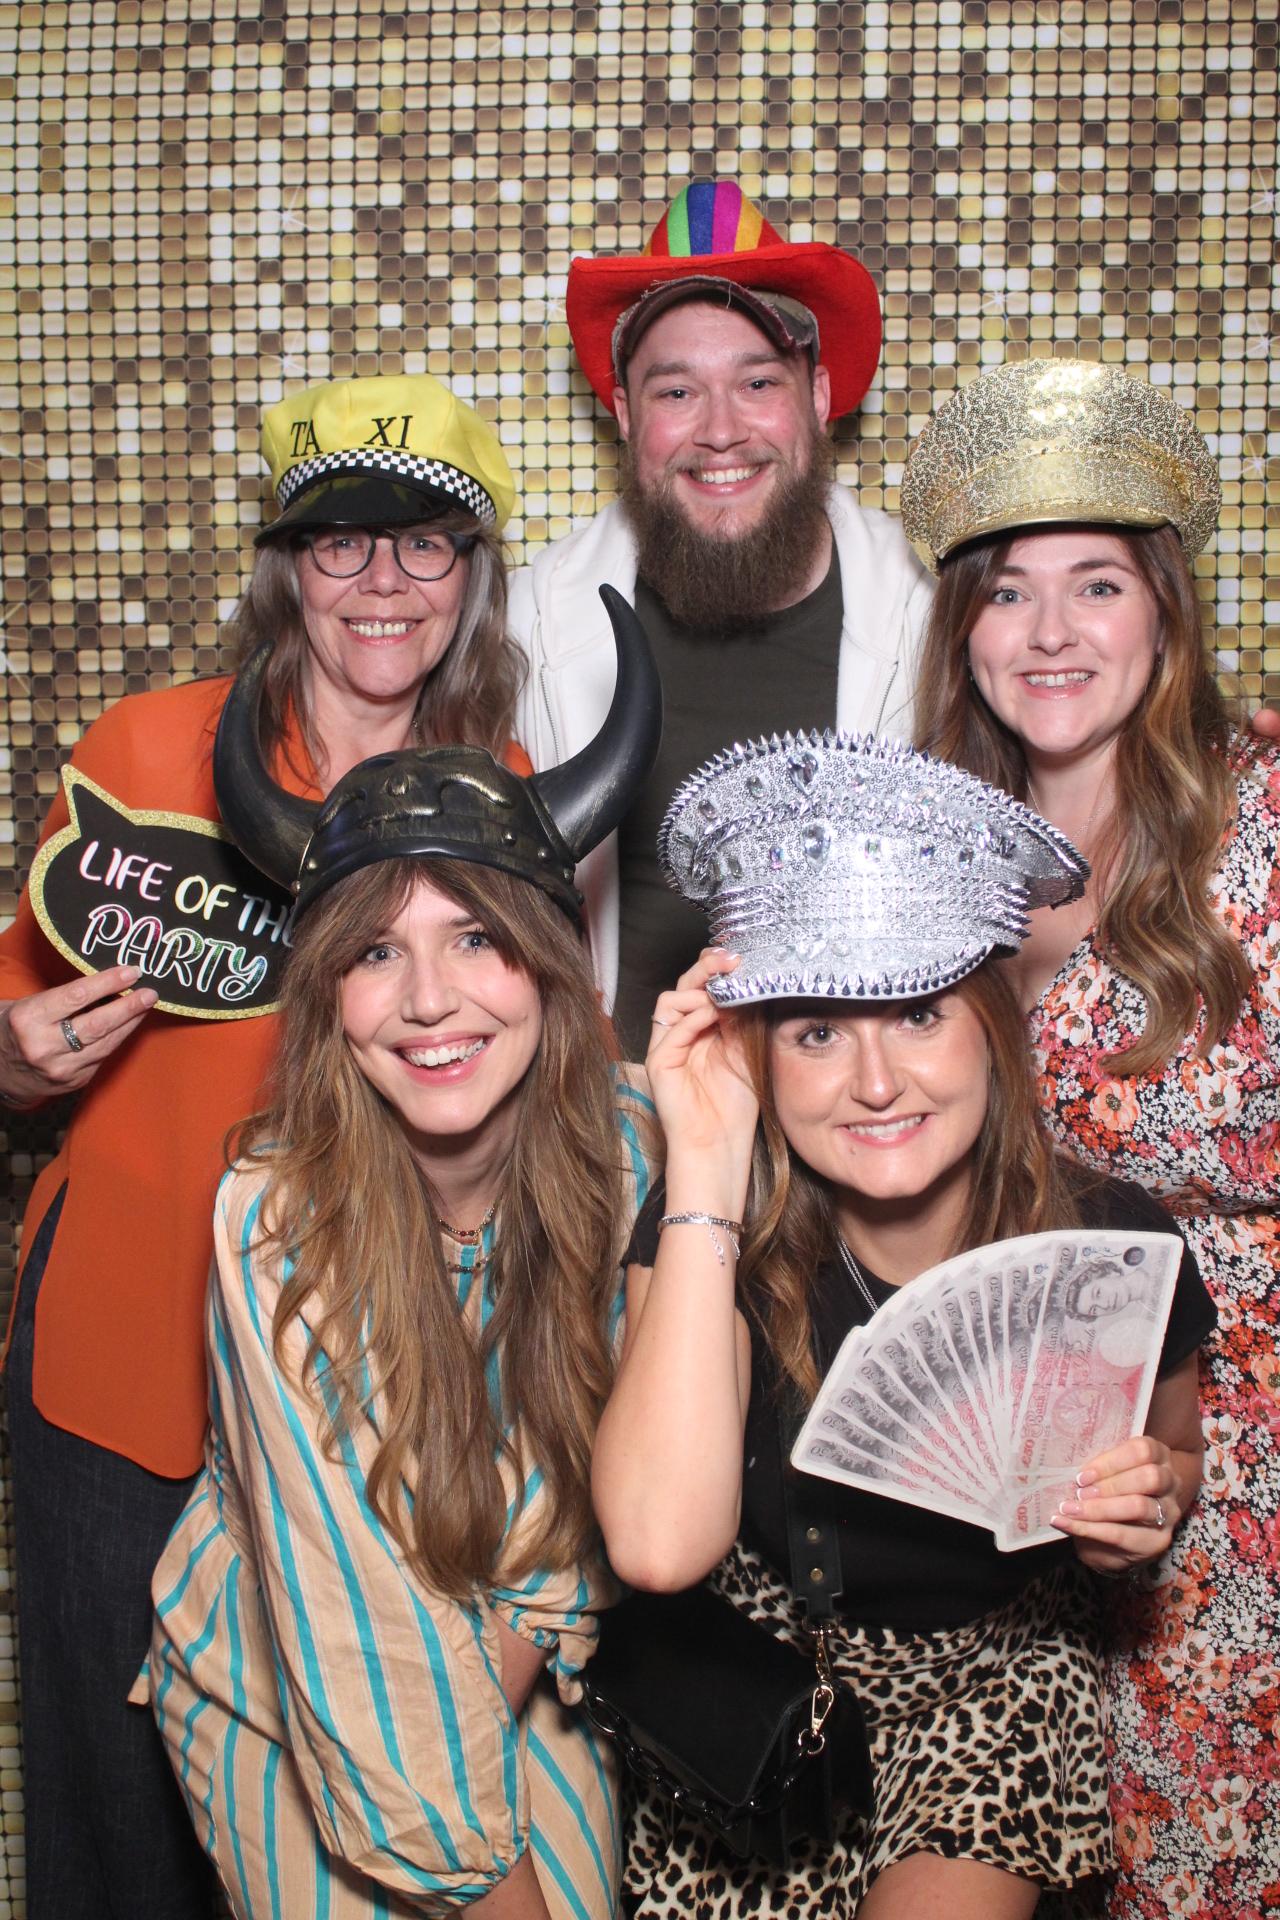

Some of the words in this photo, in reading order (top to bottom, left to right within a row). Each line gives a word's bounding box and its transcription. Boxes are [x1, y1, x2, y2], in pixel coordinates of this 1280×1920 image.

[79, 840, 173, 901] LIFE
[175, 874, 237, 921] OF
[81, 903, 268, 1002] PARTY
[1022, 1439, 1035, 1469] £50
[1017, 1505, 1028, 1533] £50
